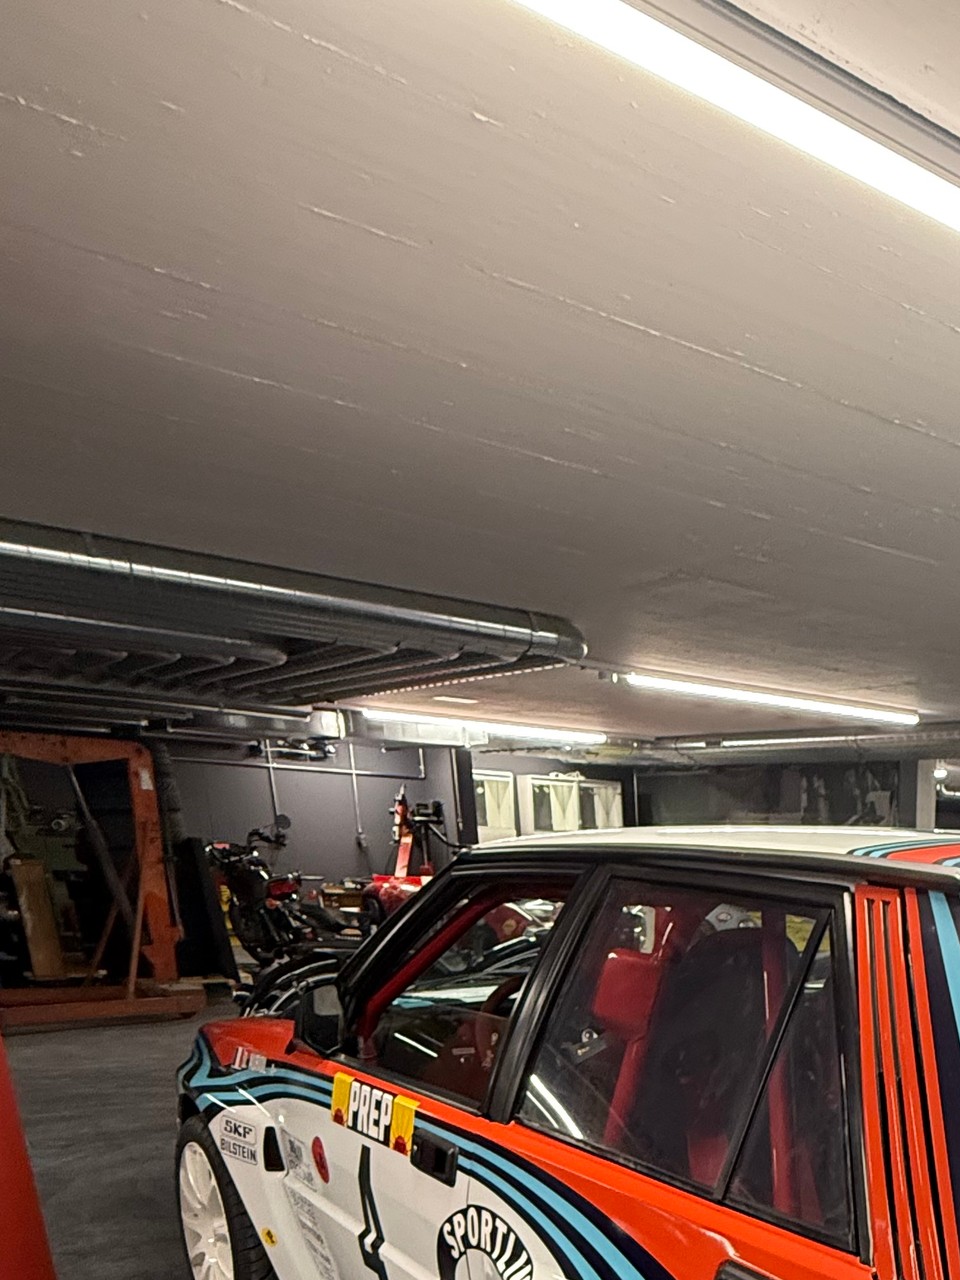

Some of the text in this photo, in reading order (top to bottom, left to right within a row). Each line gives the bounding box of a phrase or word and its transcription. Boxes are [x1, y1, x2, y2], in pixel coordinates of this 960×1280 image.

[347, 1081, 393, 1142] PREP
[224, 1119, 252, 1139] SKF
[221, 1138, 257, 1162] BILSTEIN
